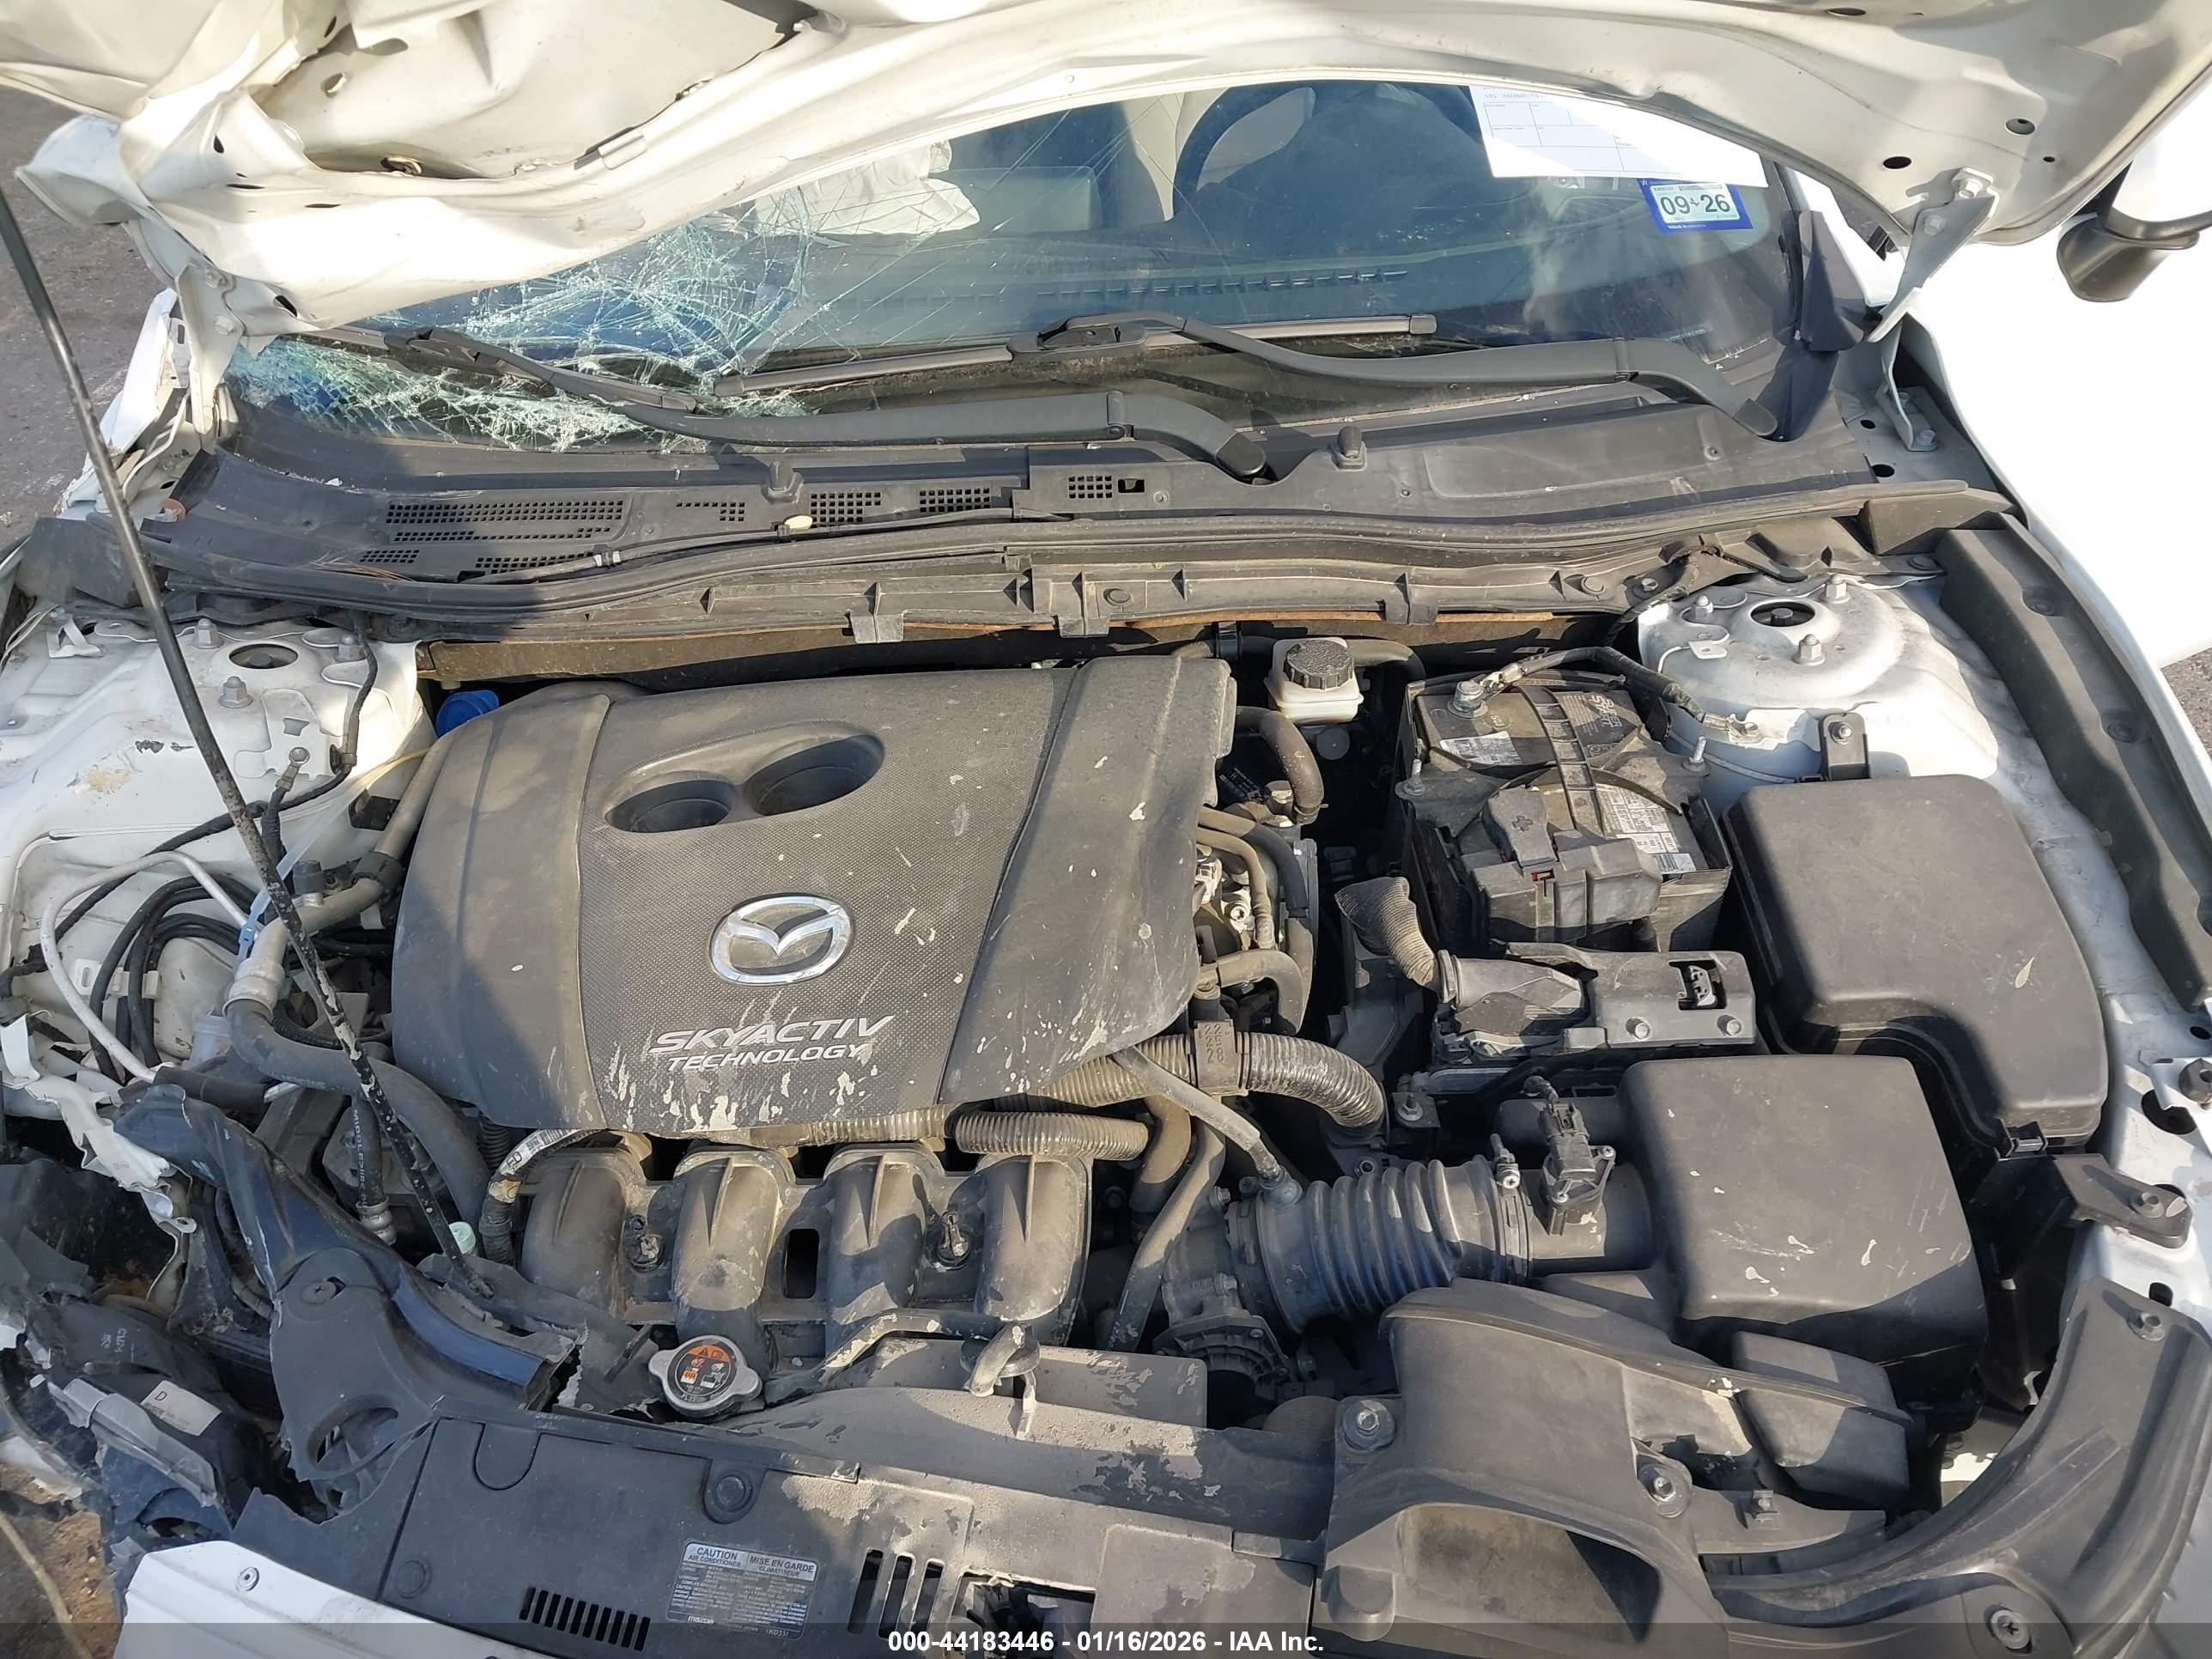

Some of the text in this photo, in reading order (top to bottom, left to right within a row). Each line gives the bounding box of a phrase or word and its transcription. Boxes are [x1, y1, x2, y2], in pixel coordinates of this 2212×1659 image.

[1660, 194, 1730, 216] 09 26
[647, 1015, 896, 1054] SKYACTIV
[666, 1043, 867, 1072] TECHNOLOGY
[1206, 1047, 1224, 1064] 28
[155, 1390, 167, 1402] D
[696, 1547, 738, 1560] CAUTION
[700, 1556, 741, 1567] CONDITIONER
[749, 1556, 770, 1565] MISE
[783, 1561, 814, 1572] GARDE
